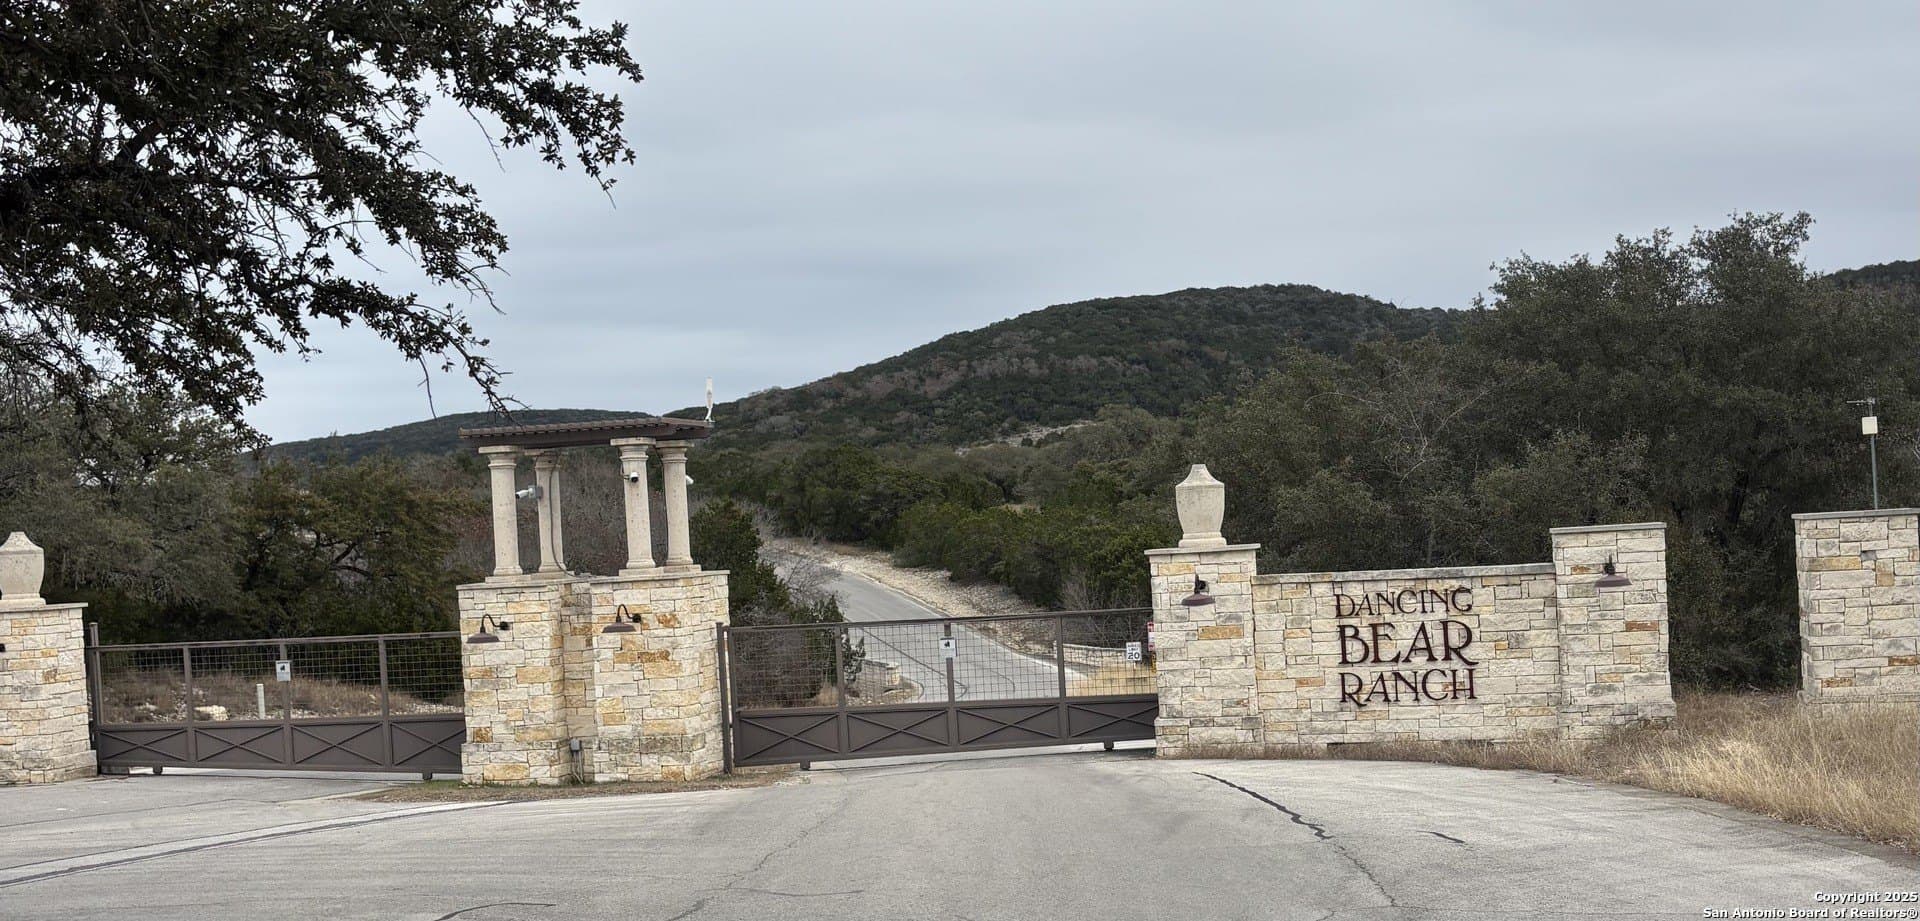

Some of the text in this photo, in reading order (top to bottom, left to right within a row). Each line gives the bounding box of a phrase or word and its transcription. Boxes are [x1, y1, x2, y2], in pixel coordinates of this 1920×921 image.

[1334, 587, 1473, 617] DANCING
[1128, 652, 1140, 660] 20
[1337, 620, 1479, 666] BEAR
[1338, 668, 1478, 707] RANCH
